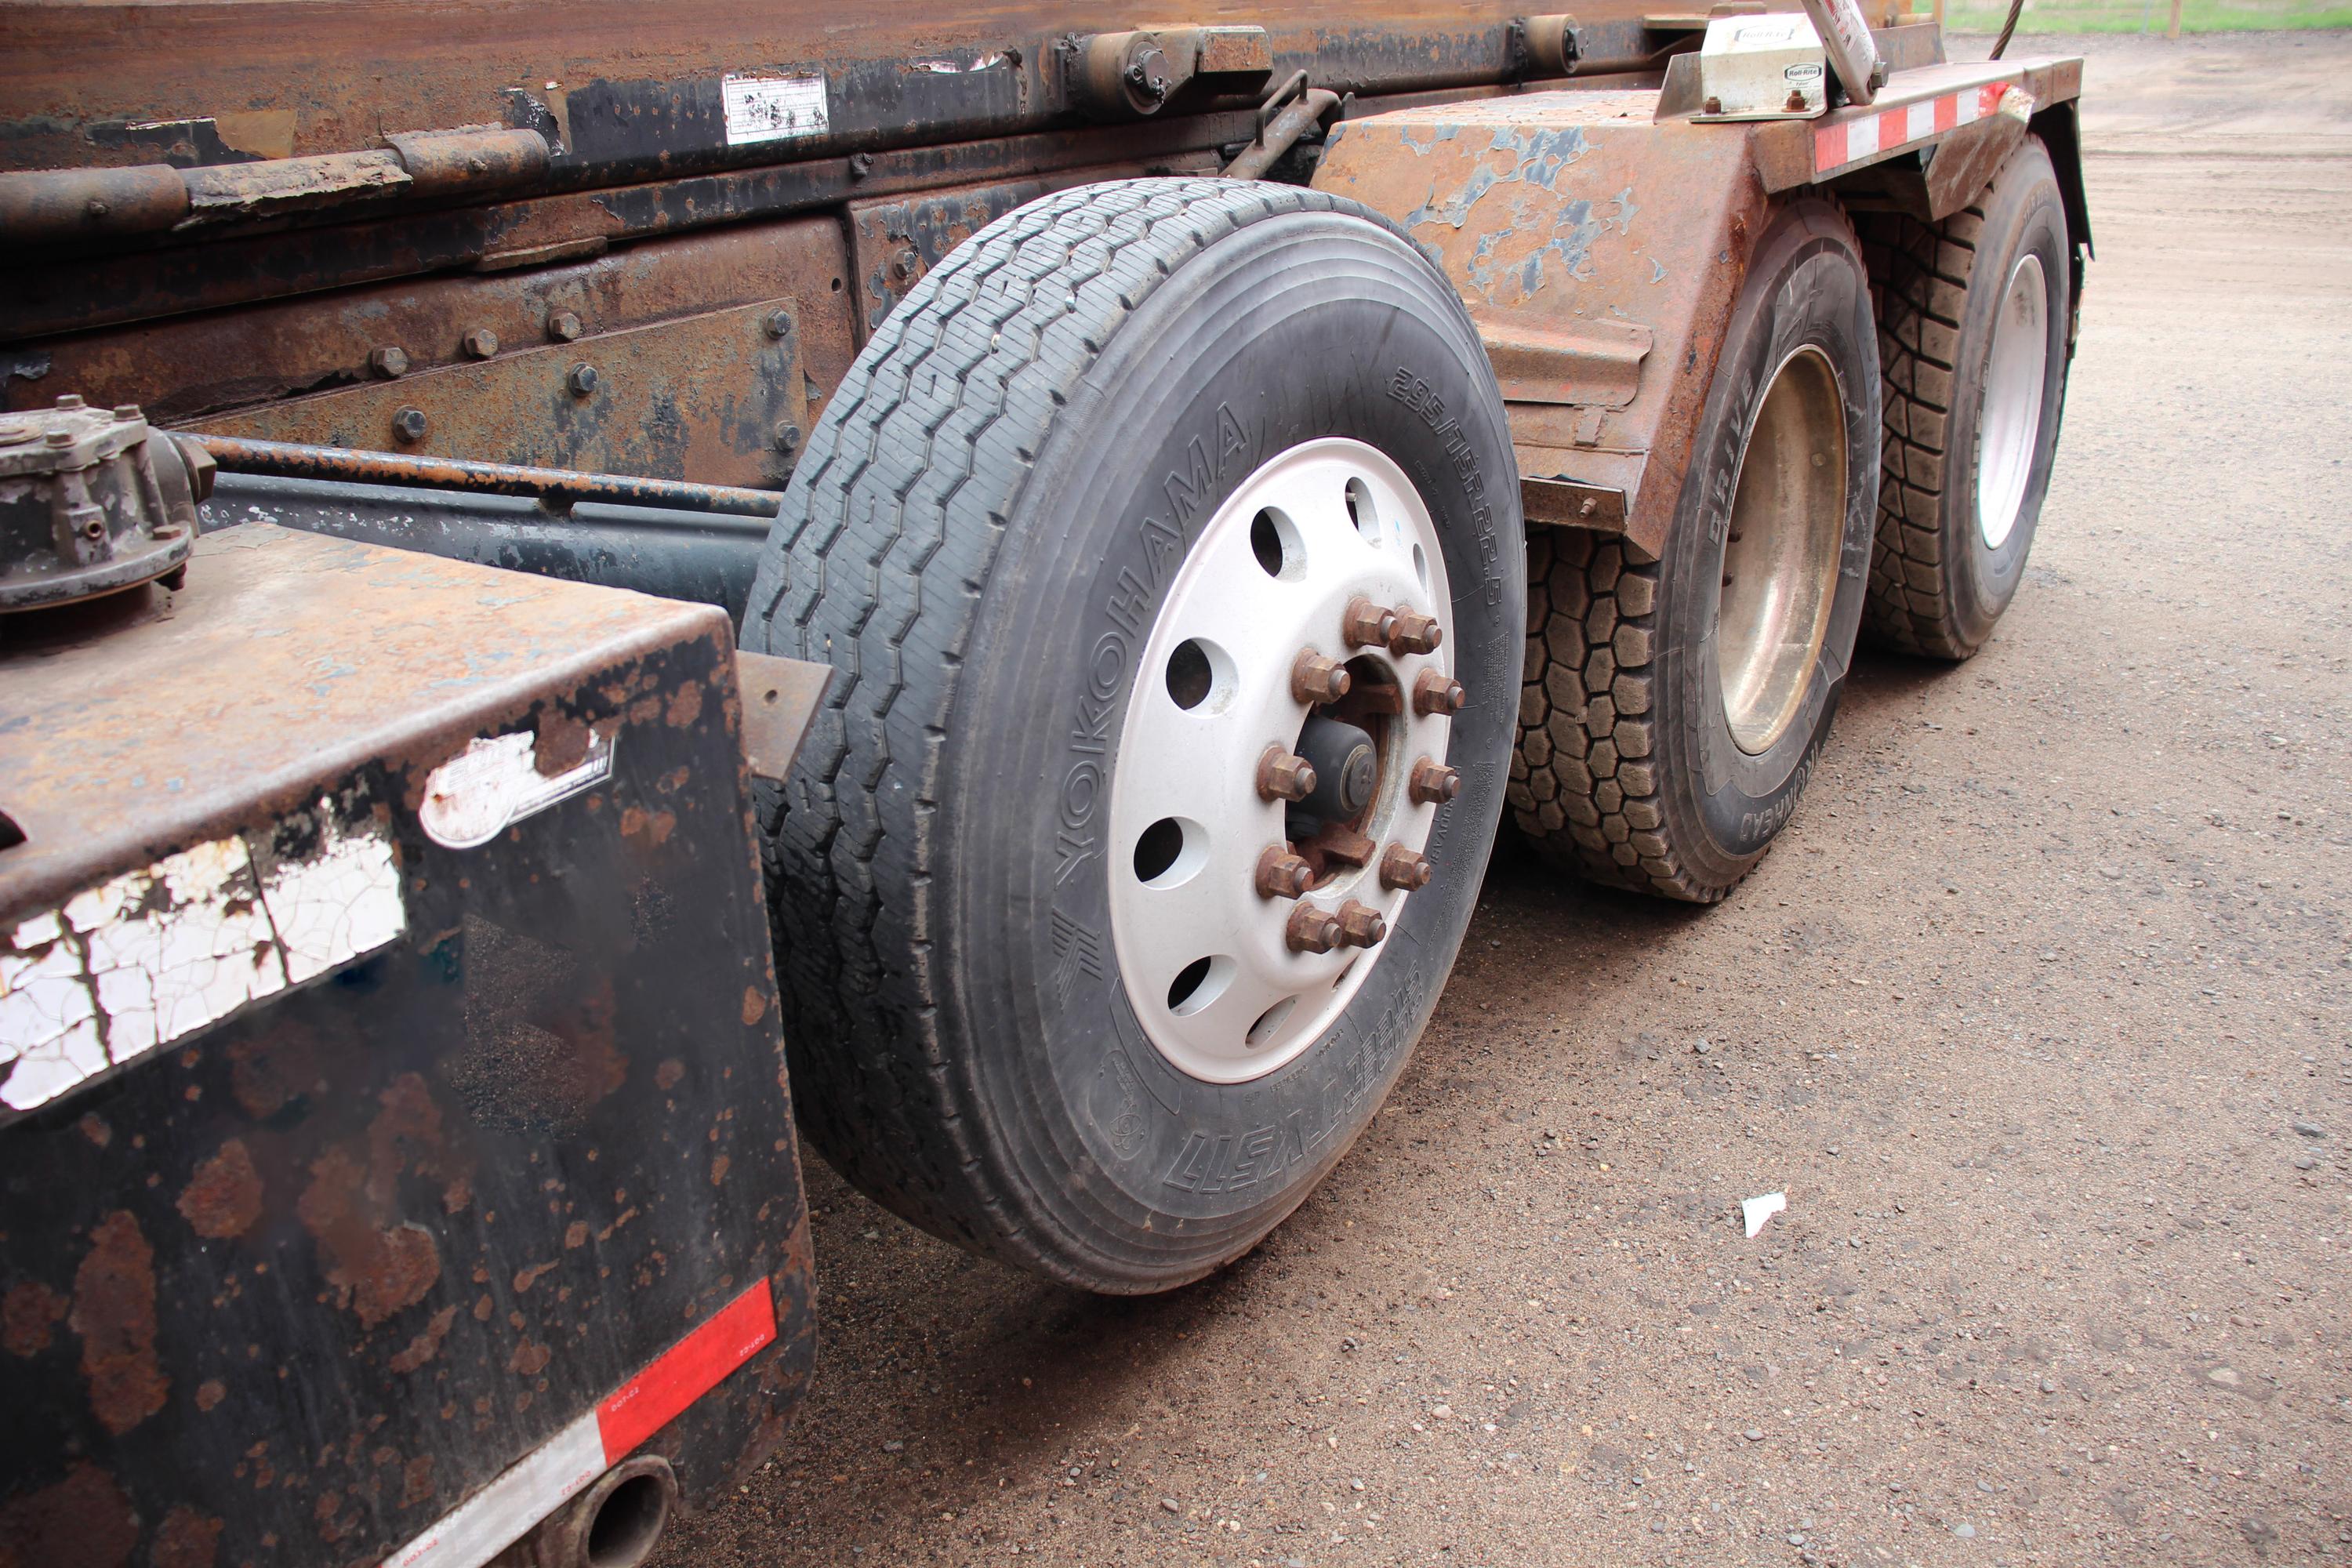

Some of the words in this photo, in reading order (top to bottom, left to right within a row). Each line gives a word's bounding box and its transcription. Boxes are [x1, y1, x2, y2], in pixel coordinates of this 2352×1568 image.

[1387, 367, 1502, 606] 295/75R22.5
[1708, 368, 1753, 546] DRIVE
[1054, 401, 1247, 891] YOKOHAMA
[611, 1386, 640, 1412] DOT-C2
